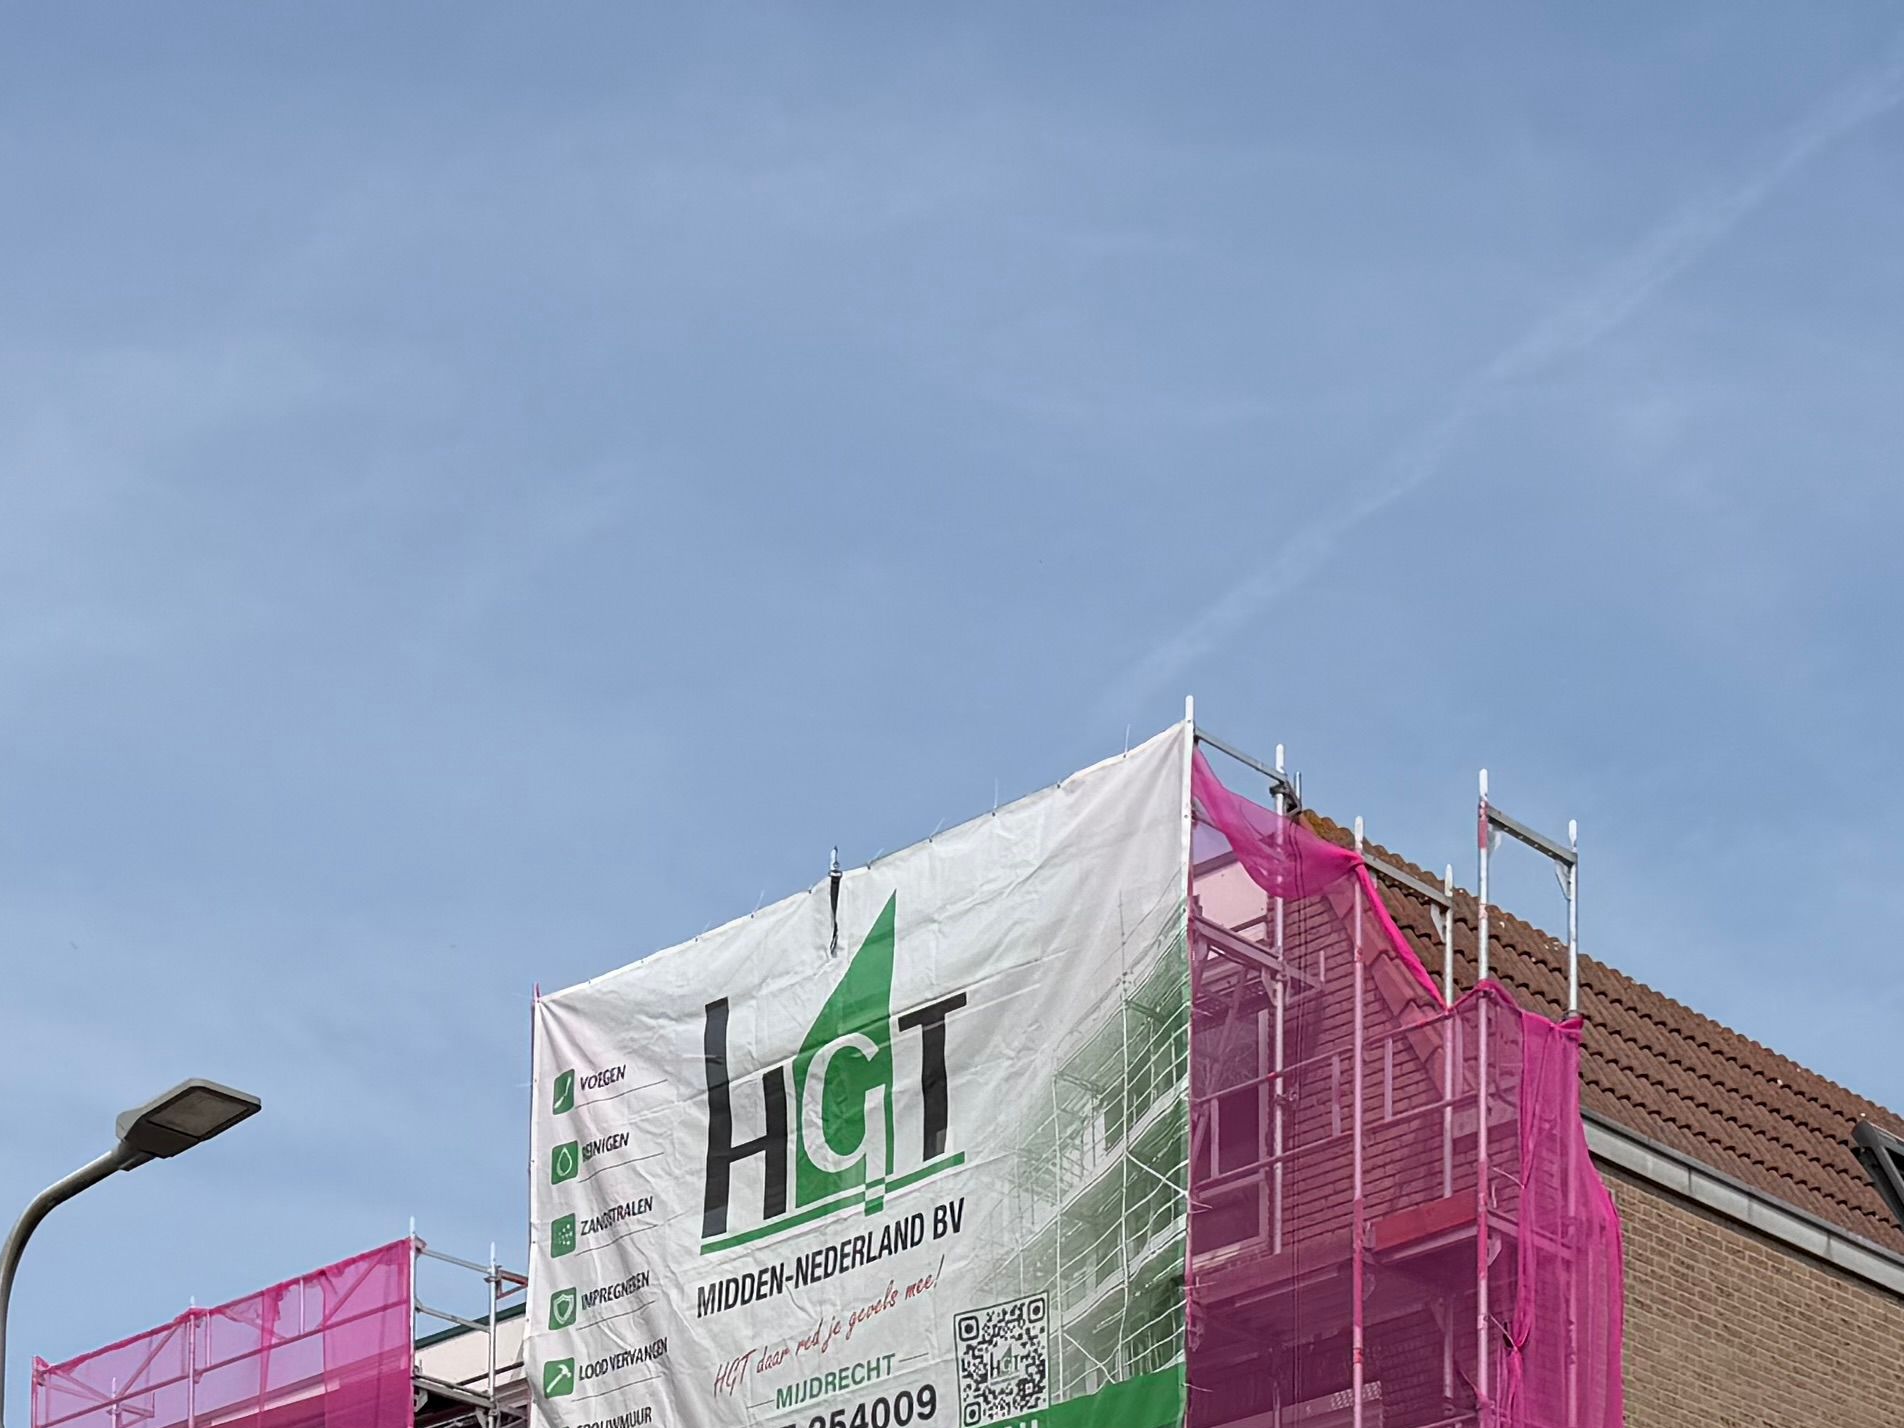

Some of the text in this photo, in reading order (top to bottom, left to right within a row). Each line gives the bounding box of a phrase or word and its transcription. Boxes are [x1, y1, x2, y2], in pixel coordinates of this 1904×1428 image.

[580, 1064, 626, 1091] VOEGEN
[701, 992, 966, 1238] HGT
[697, 1196, 965, 1318] MIDDEN-NEDERLAND BV
[714, 1348, 757, 1398] HGT
[795, 1317, 824, 1356] red
[821, 1315, 842, 1353] je
[776, 1353, 896, 1409] MIJDRECHT
